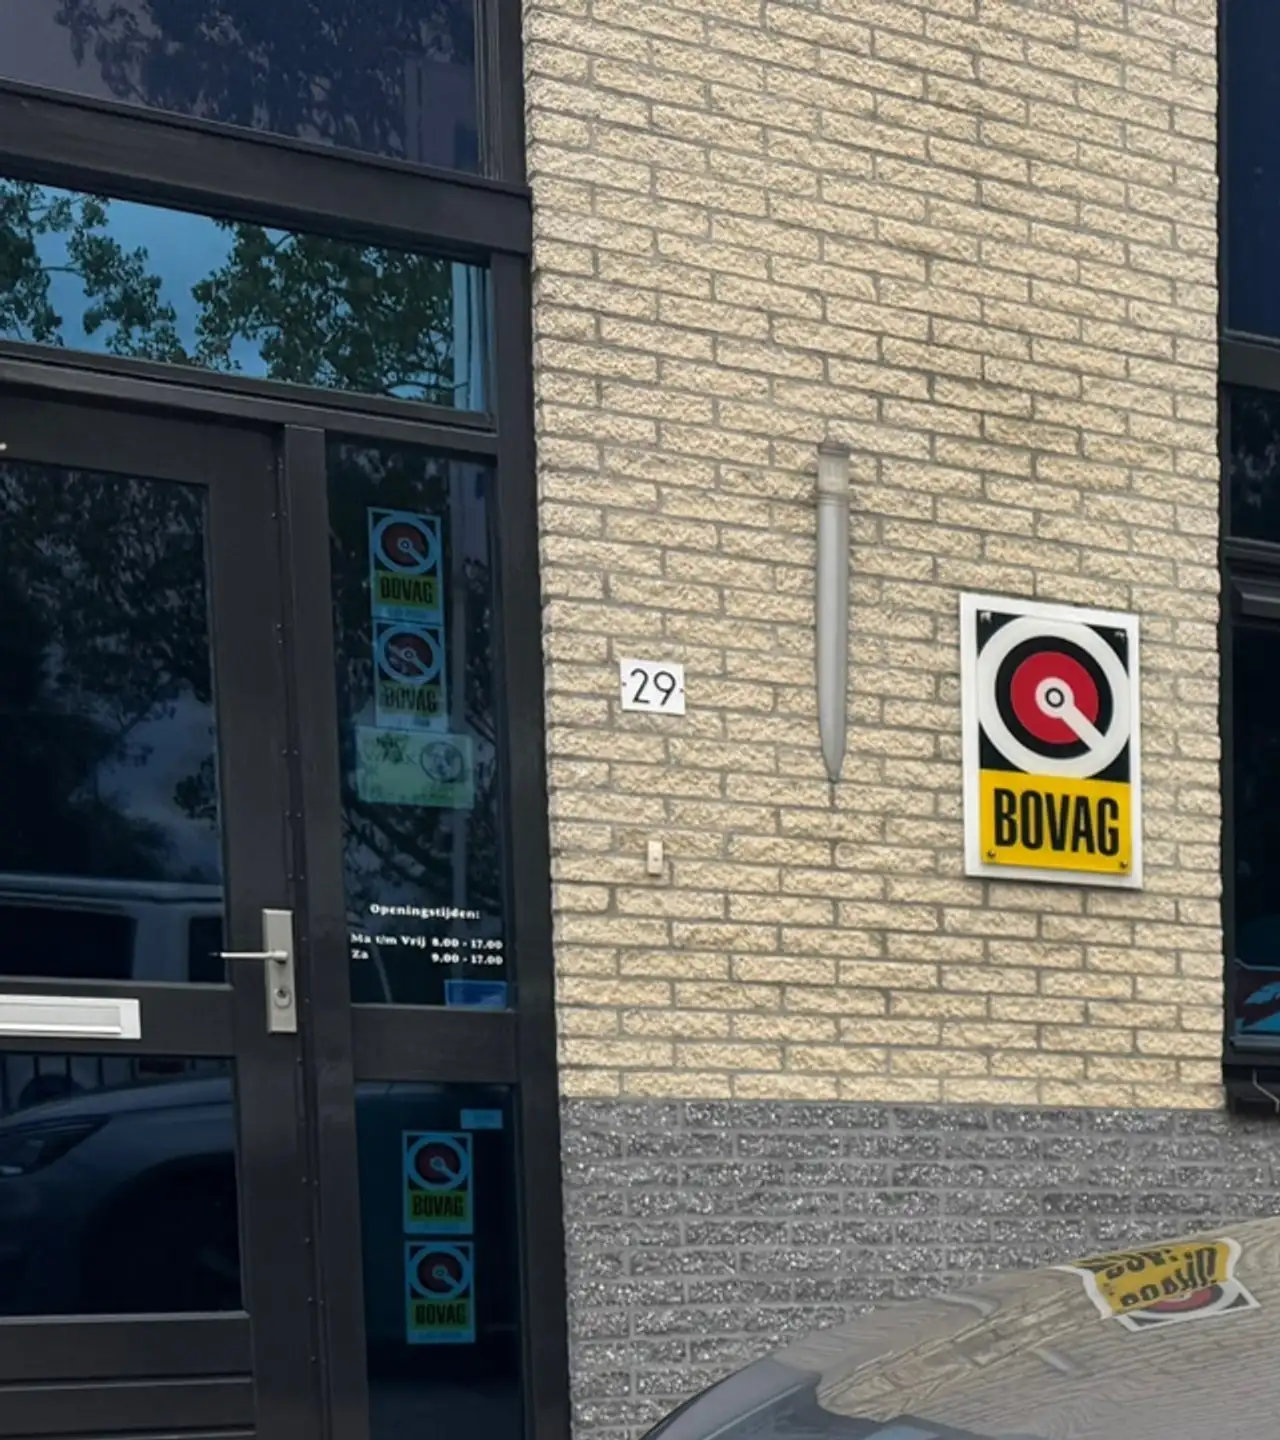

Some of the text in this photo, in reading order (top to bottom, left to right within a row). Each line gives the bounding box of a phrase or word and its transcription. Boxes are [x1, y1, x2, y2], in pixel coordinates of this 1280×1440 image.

[628, 667, 678, 707] 29
[992, 787, 1120, 857] BOVAG
[369, 903, 481, 920] Openingstijden:
[350, 933, 371, 945] Ma
[375, 934, 398, 946] t/m
[400, 935, 426, 949] Vrij
[431, 937, 459, 948] 8.00
[470, 938, 504, 950] 17.00
[351, 949, 369, 960] Za
[431, 952, 459, 964] 9.00
[470, 954, 504, 965] 17.00
[412, 1194, 465, 1218] BOVAG
[415, 1302, 467, 1326] BOVAG
